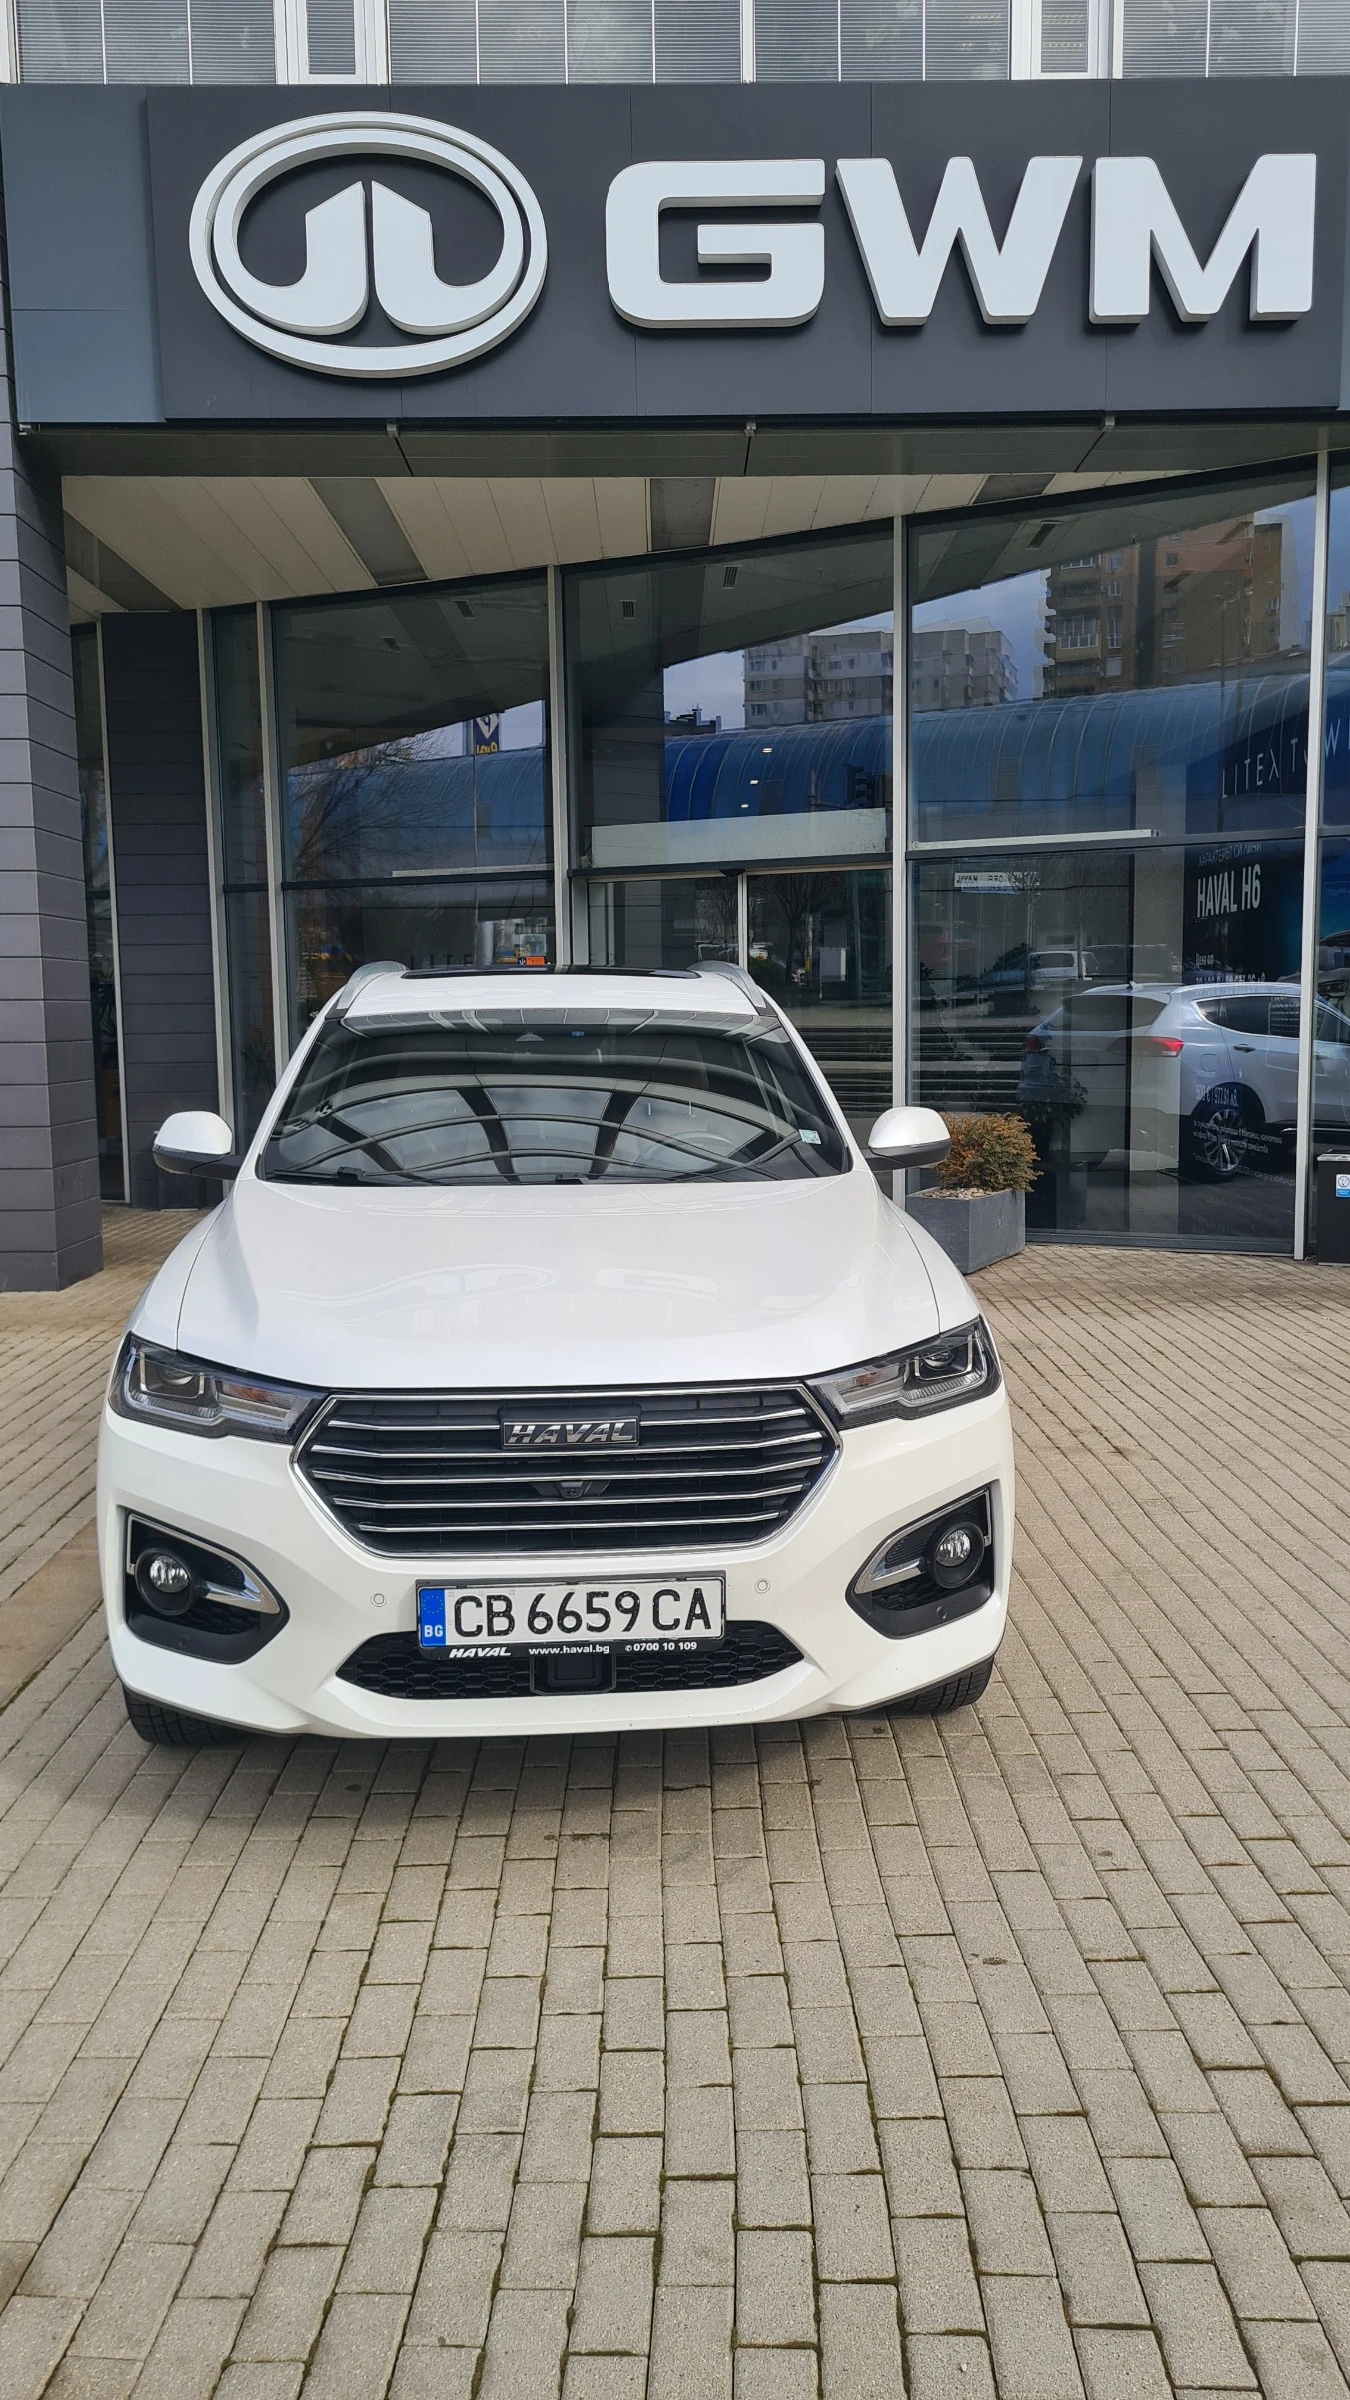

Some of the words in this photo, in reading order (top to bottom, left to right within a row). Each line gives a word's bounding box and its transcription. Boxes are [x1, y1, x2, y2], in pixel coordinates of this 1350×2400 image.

[605, 153, 1317, 328] GWM
[1197, 870, 1237, 918] HAVAL
[1241, 863, 1261, 911] H6
[508, 1422, 634, 1444] HAVAL
[454, 1594, 516, 1638] CB
[527, 1590, 640, 1635] 6659
[652, 1587, 712, 1632] CA
[424, 1624, 444, 1638] BG
[449, 1646, 512, 1659] HAVAL
[528, 1644, 610, 1655] www.haval.bg
[633, 1642, 659, 1651] 0700
[662, 1642, 675, 1651] 10
[678, 1641, 698, 1650] 109
